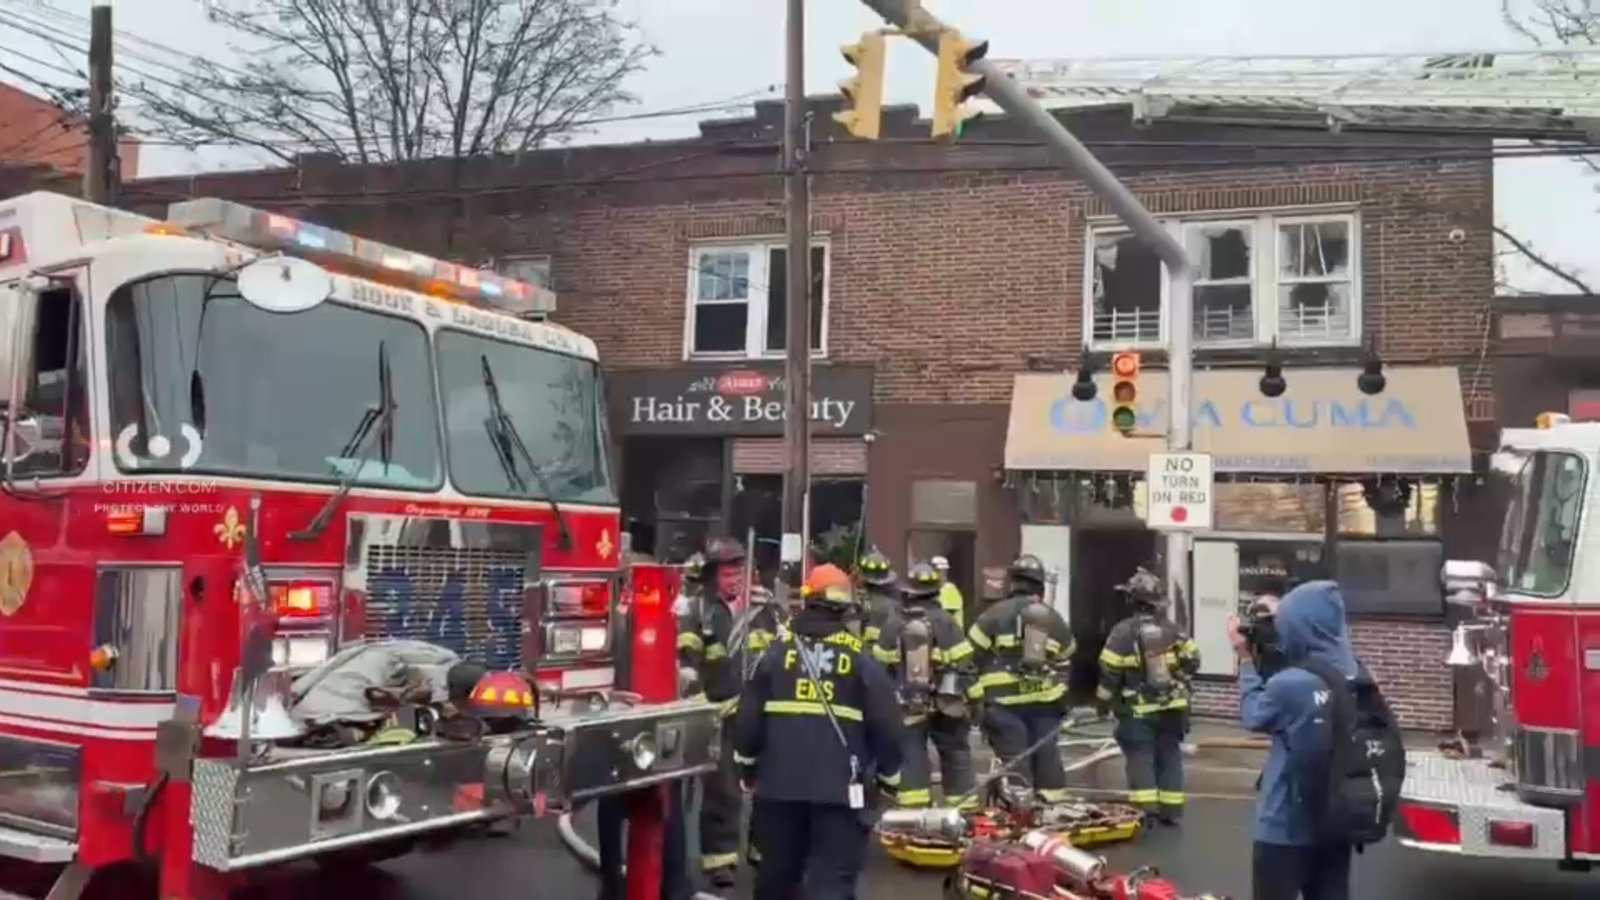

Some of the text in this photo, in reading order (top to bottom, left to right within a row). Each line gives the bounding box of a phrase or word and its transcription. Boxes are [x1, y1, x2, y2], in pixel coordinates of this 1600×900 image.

[632, 396, 855, 427] Hair & Bety
[1135, 398, 1417, 428] VA CUMA
[1166, 457, 1194, 472] NO
[1162, 475, 1199, 488] TURN
[1152, 491, 1206, 503] ON RED
[784, 650, 851, 674] F D
